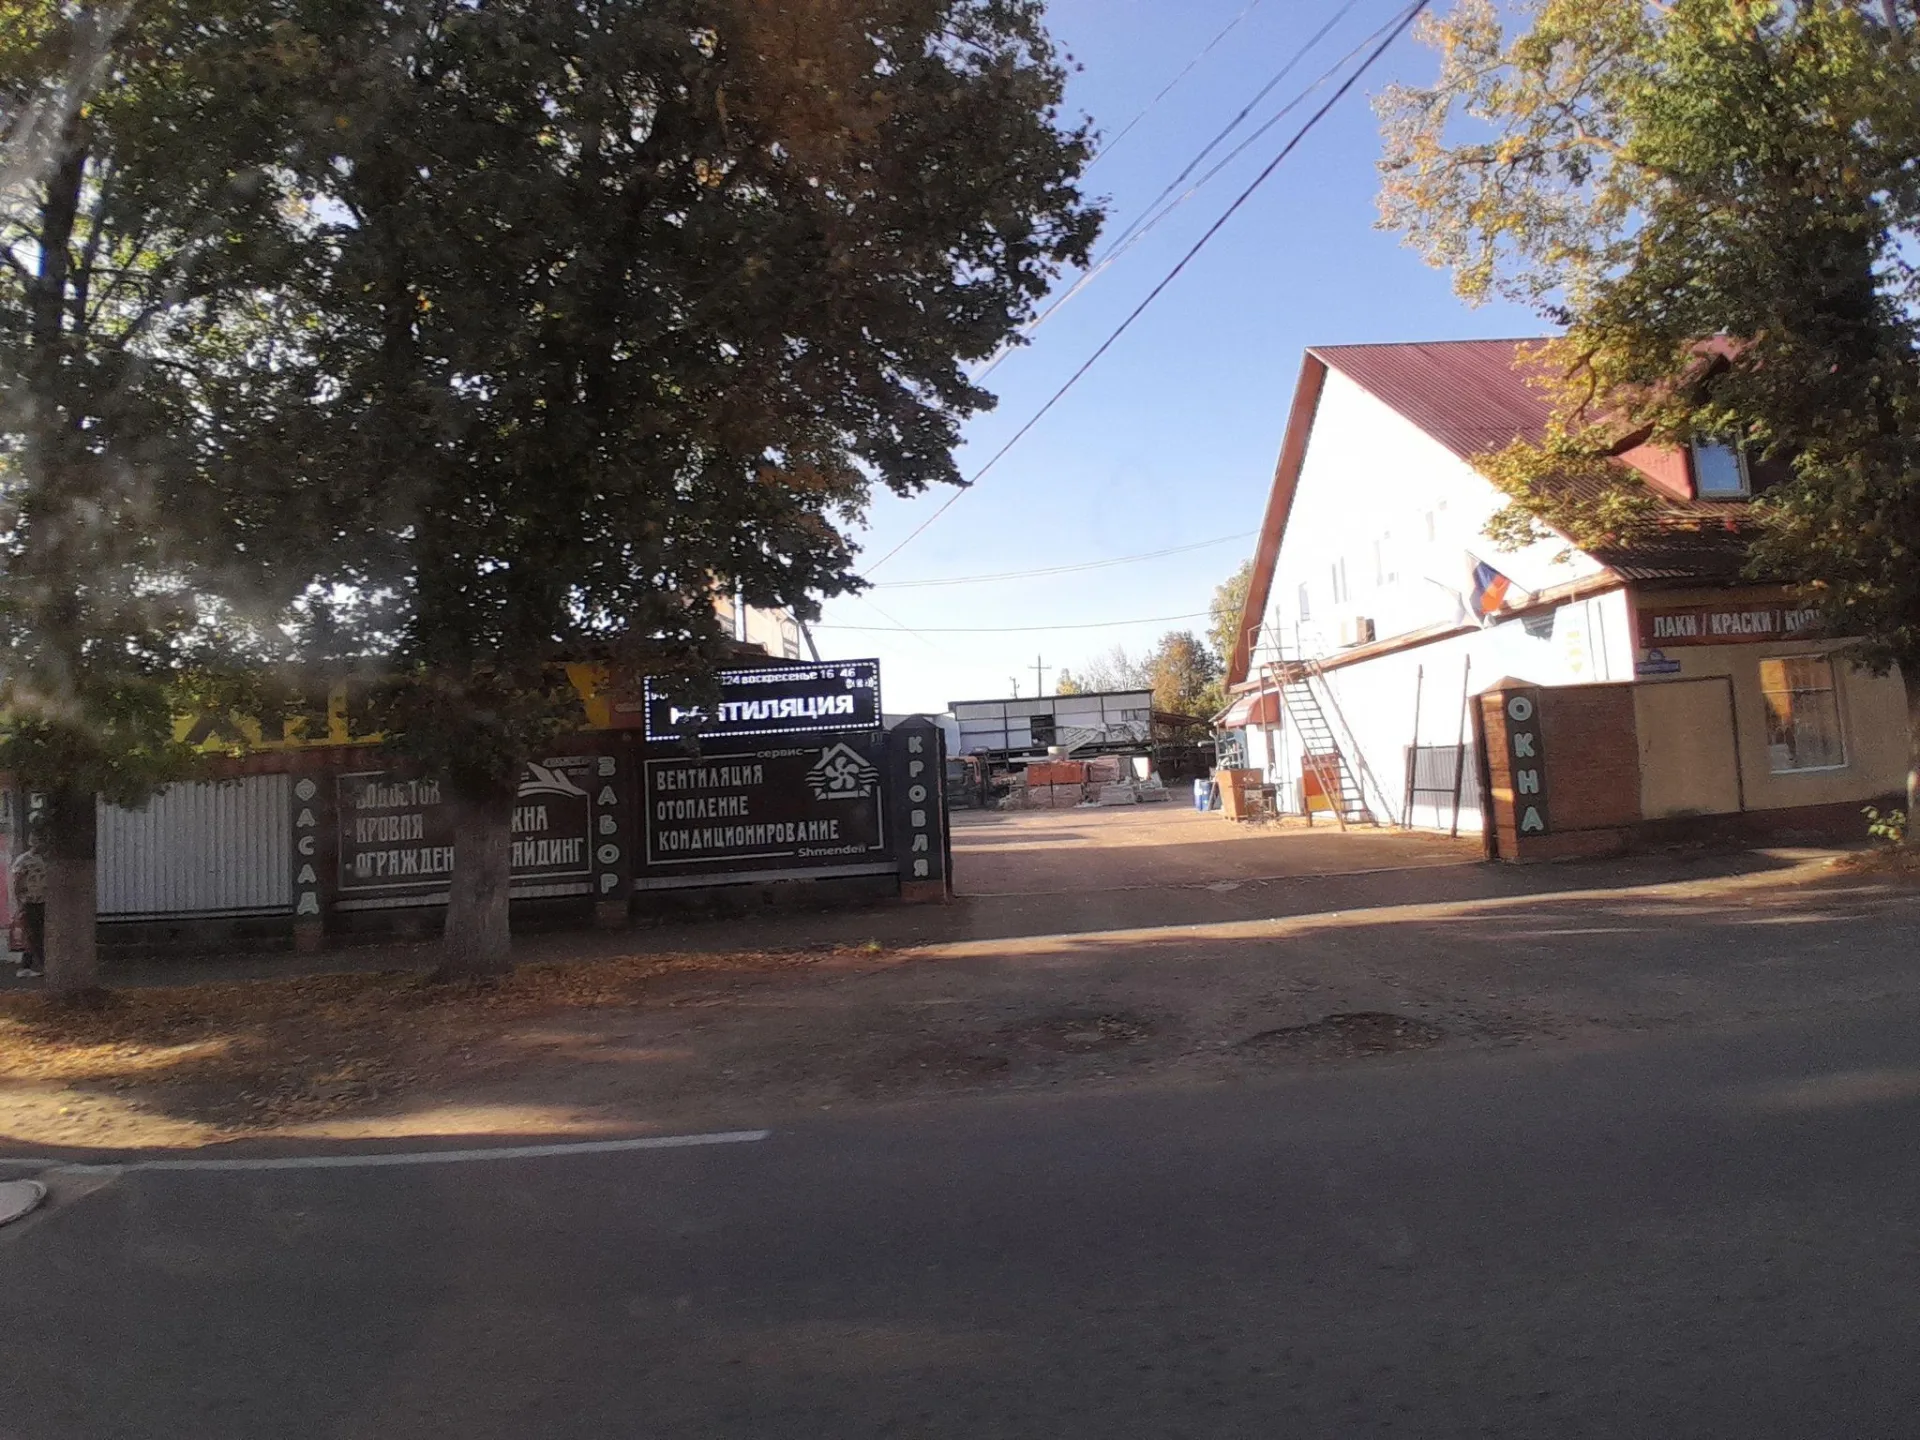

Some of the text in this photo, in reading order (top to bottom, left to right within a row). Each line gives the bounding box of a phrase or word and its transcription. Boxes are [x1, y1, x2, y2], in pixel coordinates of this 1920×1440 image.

[1653, 615, 1697, 637] ЛАКИ
[1712, 612, 1772, 635] КРАСКИ
[820, 669, 834, 680] 16
[840, 667, 856, 678] 46
[670, 694, 854, 724] ТИЛЯЦИЯ
[756, 748, 803, 760] сервис
[1509, 695, 1545, 833] ОКНА
[656, 764, 764, 791] ВЕНТИЛЯЦИЯ
[656, 795, 750, 821] ОТОПЛЕНИЕ
[907, 735, 930, 877] КРОВЛЯ
[355, 805, 549, 843] КРОВЛЯ КНА
[657, 819, 841, 852] КОНДИЦИОНИРОВАНИЕ
[295, 779, 320, 916] ФАСАД
[355, 835, 585, 877] ОГРАЖДЕН АЙДИНГ
